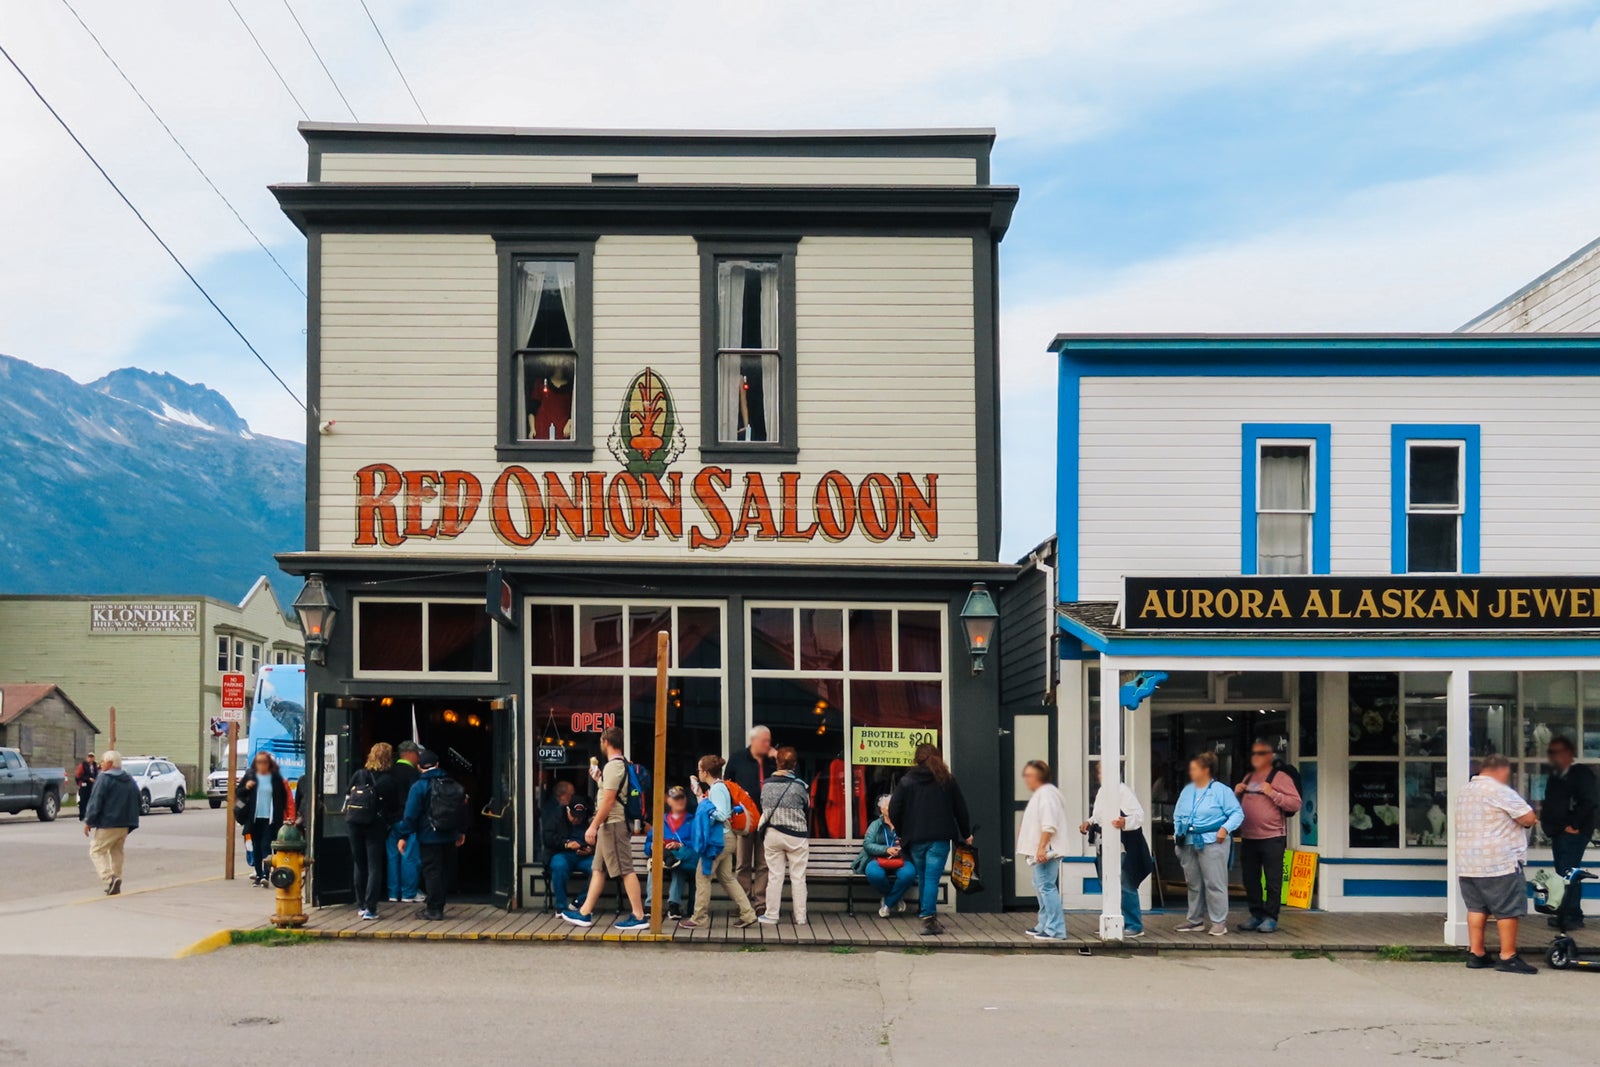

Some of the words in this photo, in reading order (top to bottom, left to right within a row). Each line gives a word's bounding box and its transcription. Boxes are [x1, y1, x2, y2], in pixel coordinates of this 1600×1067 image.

[352, 463, 482, 549] RED
[489, 465, 684, 550] ONION
[688, 465, 939, 551] SALOON
[1139, 588, 1293, 619] AURORA
[1301, 588, 1479, 619] ALASKAN
[93, 609, 196, 622] KLONDIKE
[572, 712, 615, 732] OPEN
[861, 730, 906, 740] BROTHEL
[909, 732, 932, 748] $20
[867, 740, 899, 748] TOURS
[539, 749, 563, 758] OPEN
